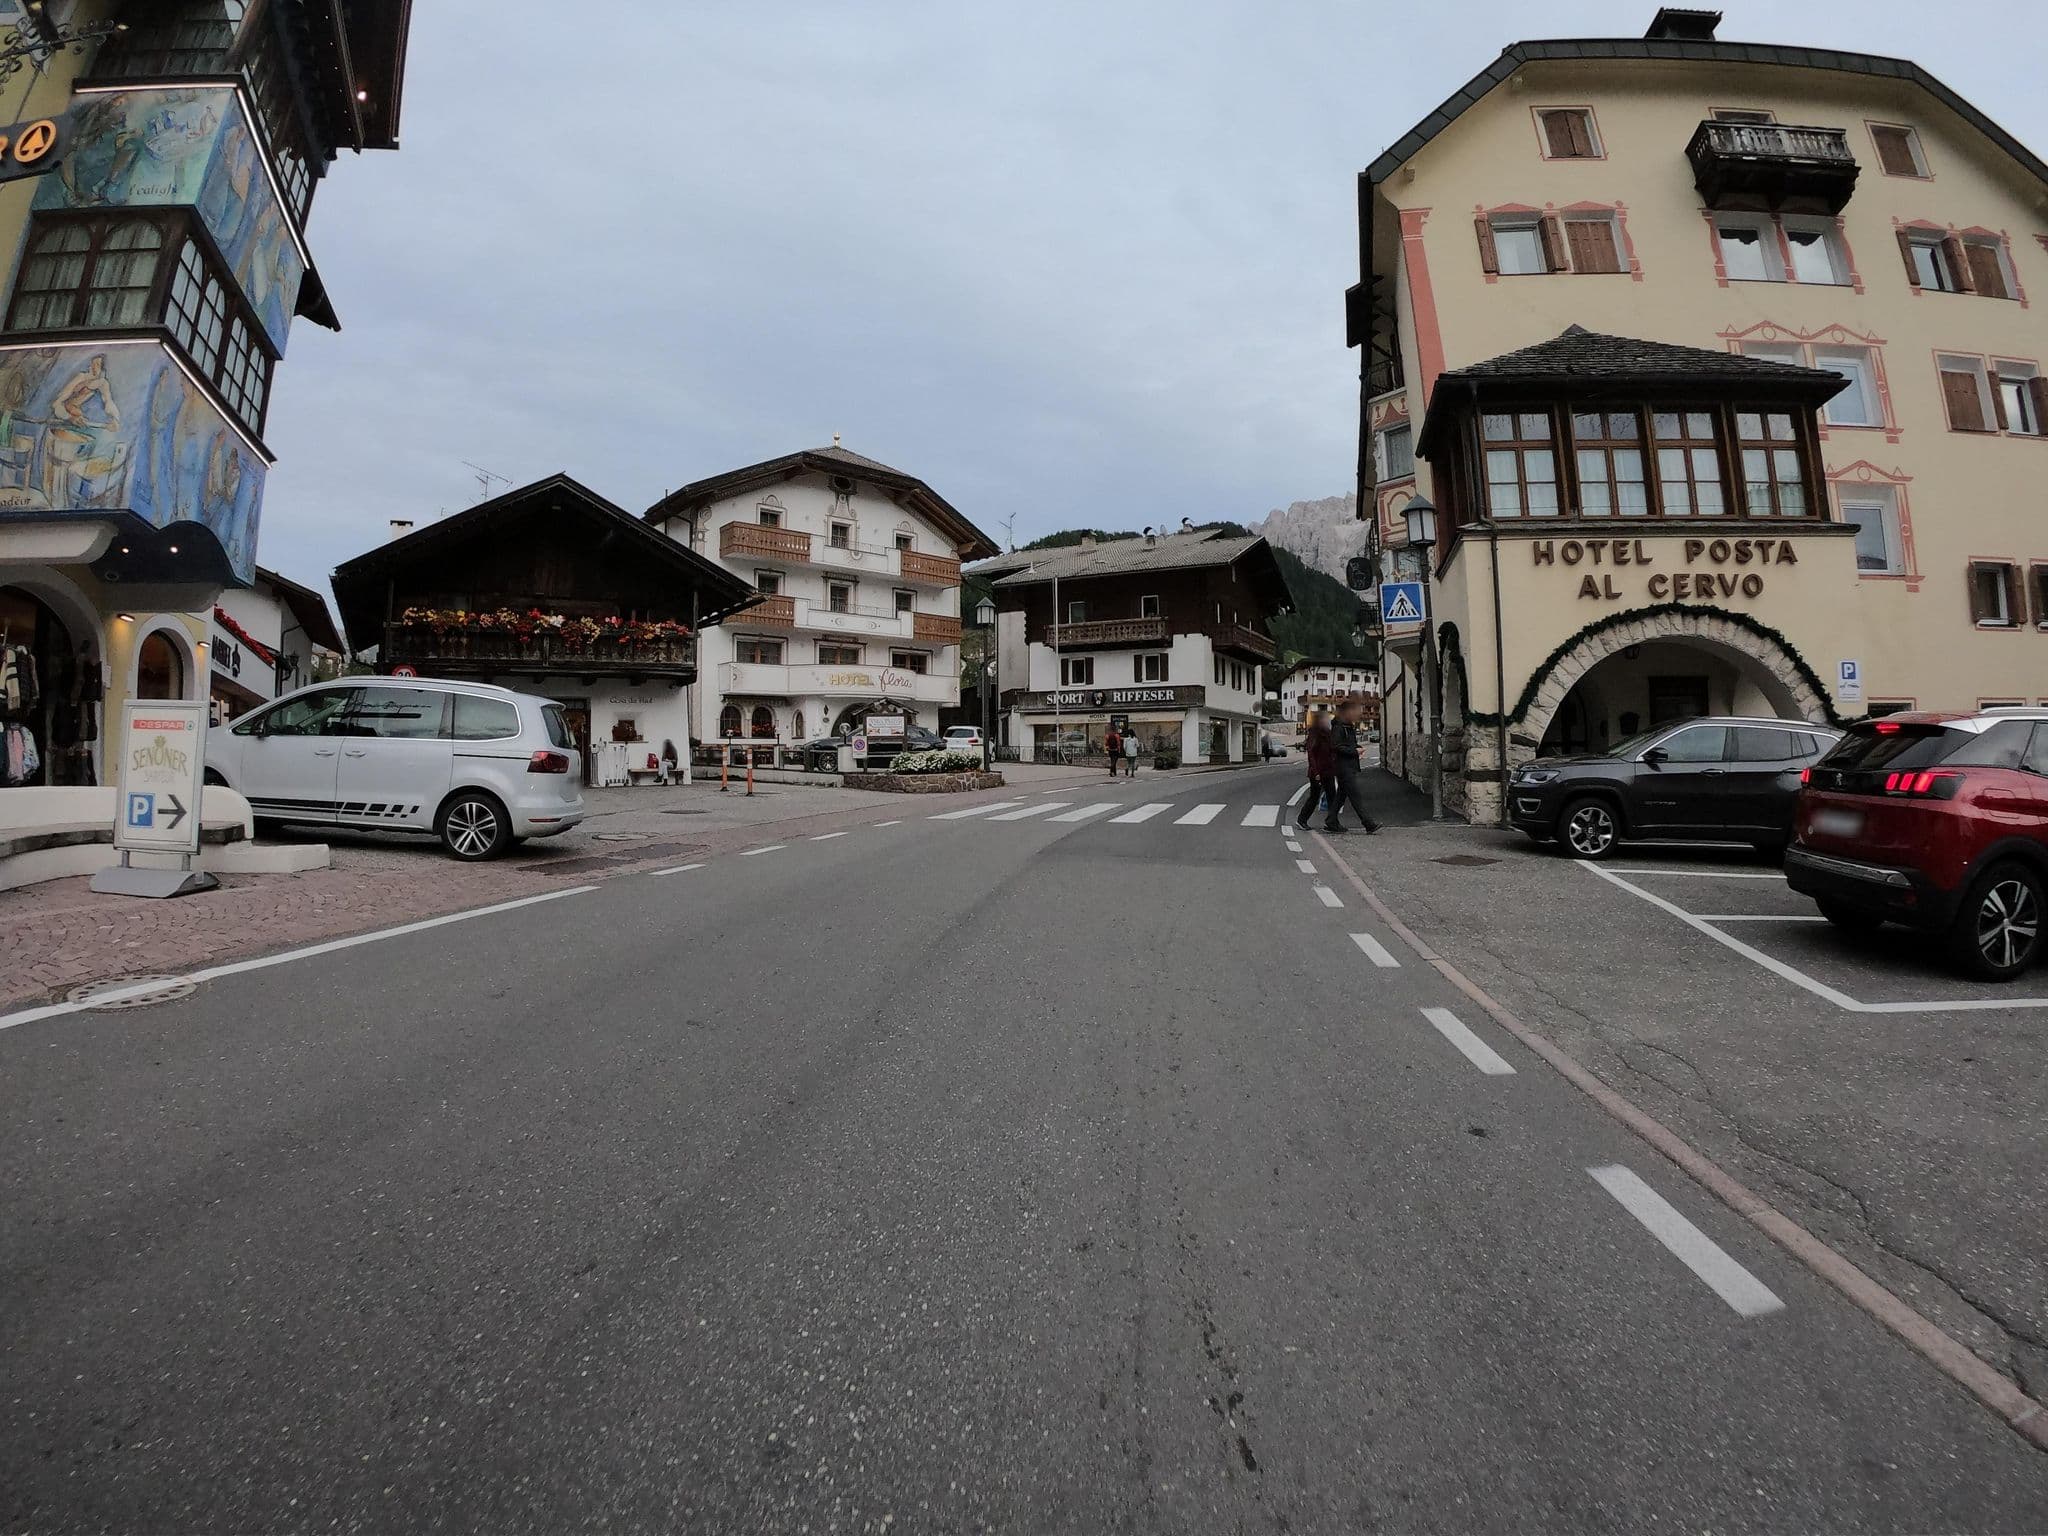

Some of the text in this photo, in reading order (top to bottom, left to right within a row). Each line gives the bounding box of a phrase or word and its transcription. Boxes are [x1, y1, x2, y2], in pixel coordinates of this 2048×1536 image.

[1533, 539, 1798, 566] HOTEL POSTA
[1578, 573, 1765, 600] AL CERVO
[829, 669, 912, 692] HOTEL flora
[1843, 664, 1854, 678] P
[1047, 689, 1175, 705] SPORT RIFFESER
[139, 720, 184, 730] DESPAR
[132, 797, 149, 824] P
